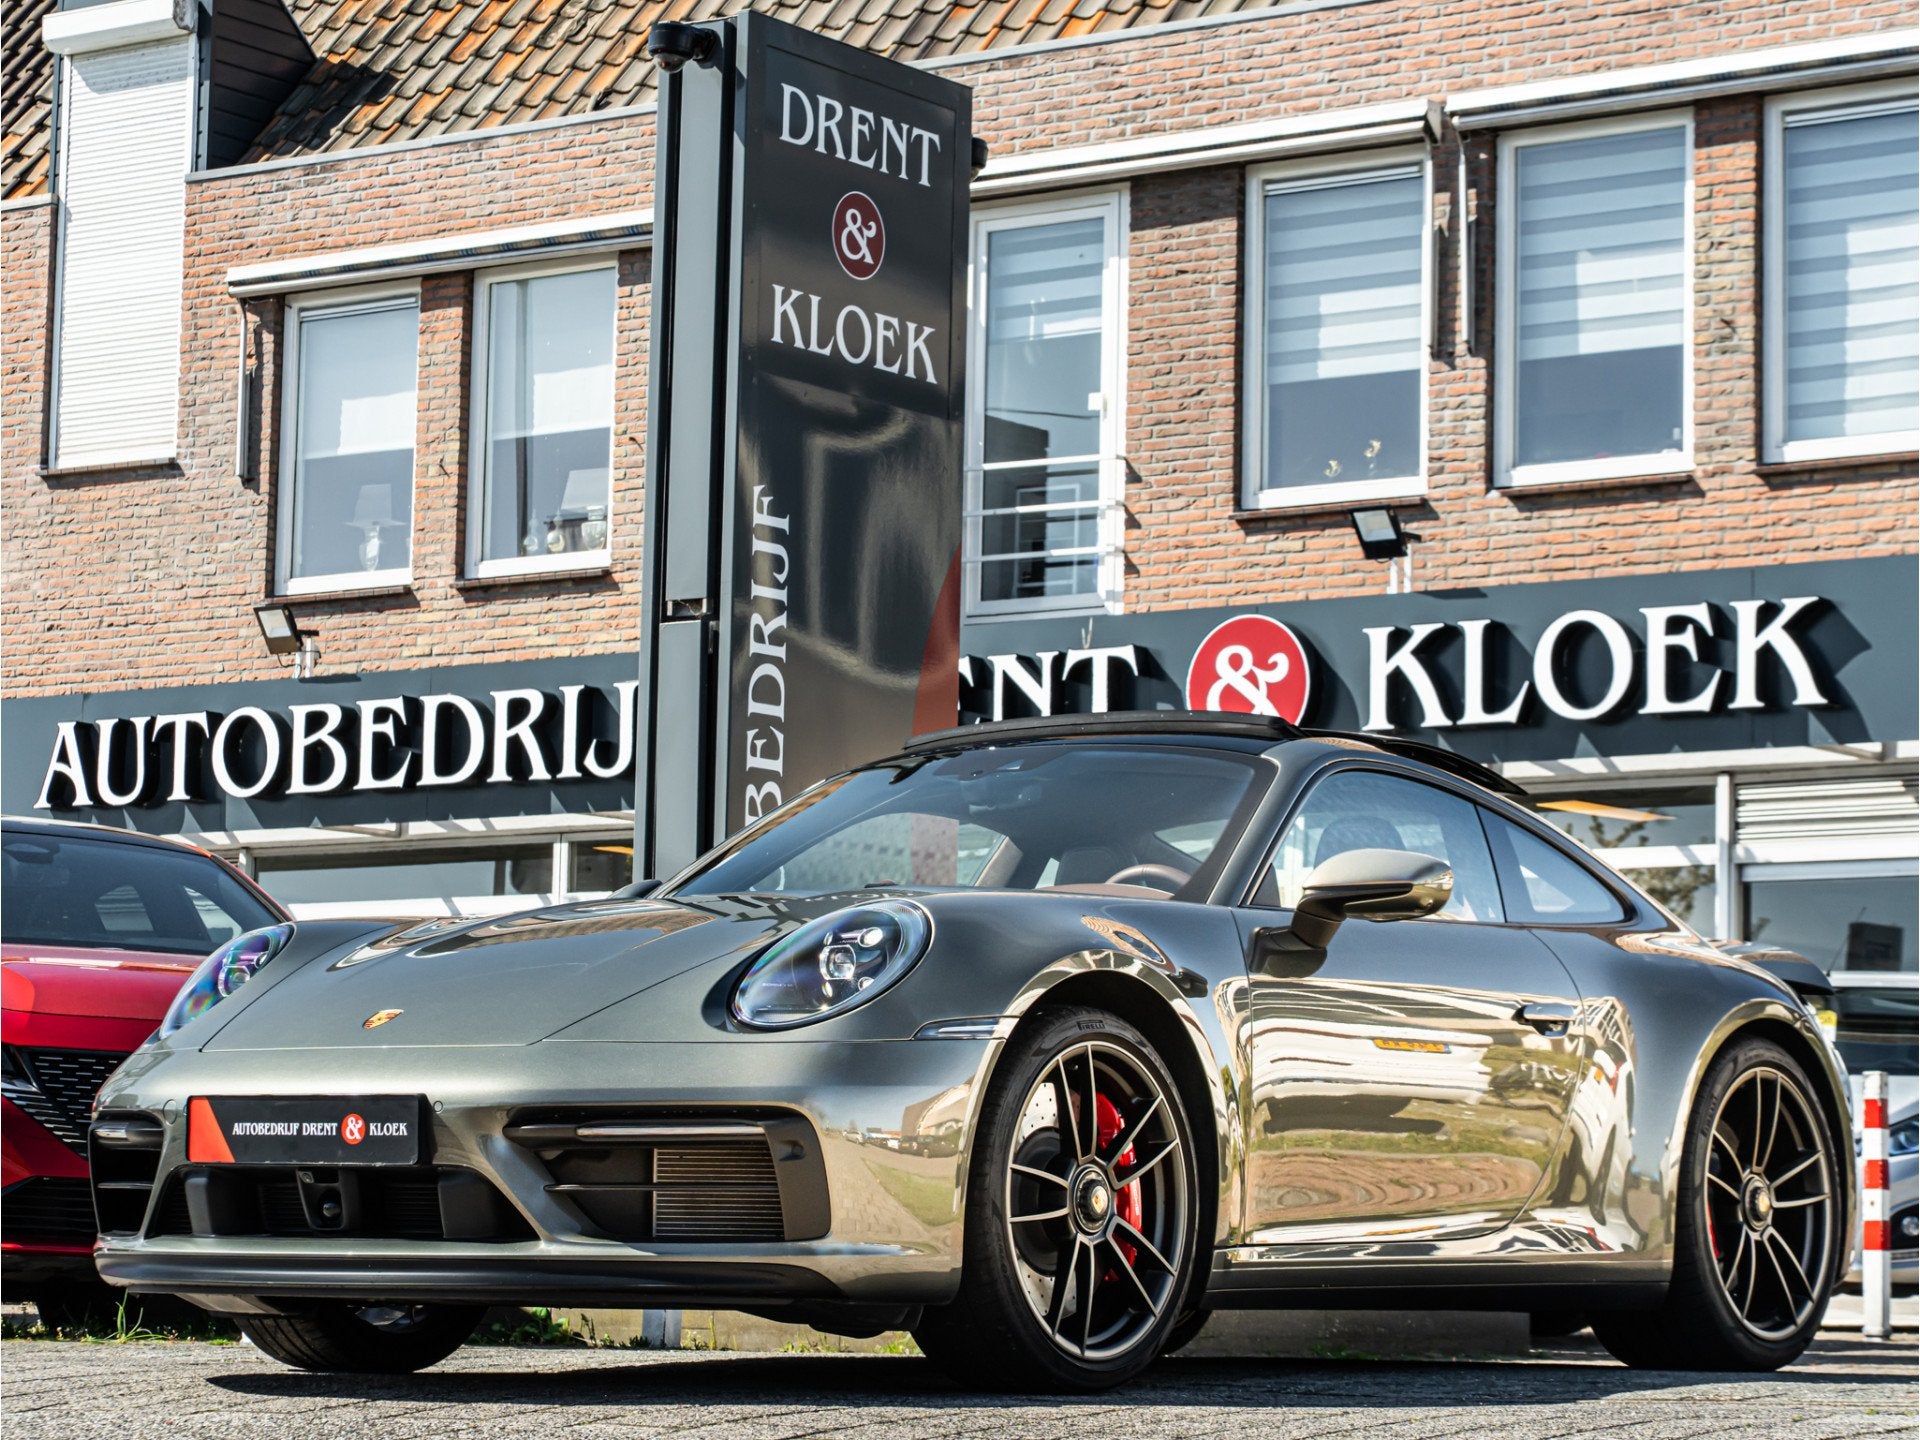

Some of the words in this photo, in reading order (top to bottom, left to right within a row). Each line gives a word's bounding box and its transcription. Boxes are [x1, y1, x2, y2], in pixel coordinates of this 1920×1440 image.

[779, 83, 941, 187] DRENT
[840, 208, 877, 265] &
[770, 283, 938, 385] KLOEK
[33, 680, 640, 810] AUTOBEDRIJ
[1206, 644, 1290, 717] &
[1361, 595, 1829, 732] KLOEK
[1076, 1020, 1106, 1031] PIRELLI
[232, 1122, 300, 1136] AUTOBEDRIJF
[302, 1122, 338, 1136] DRENT
[345, 1116, 364, 1140] &
[369, 1122, 408, 1136] KLOEK
